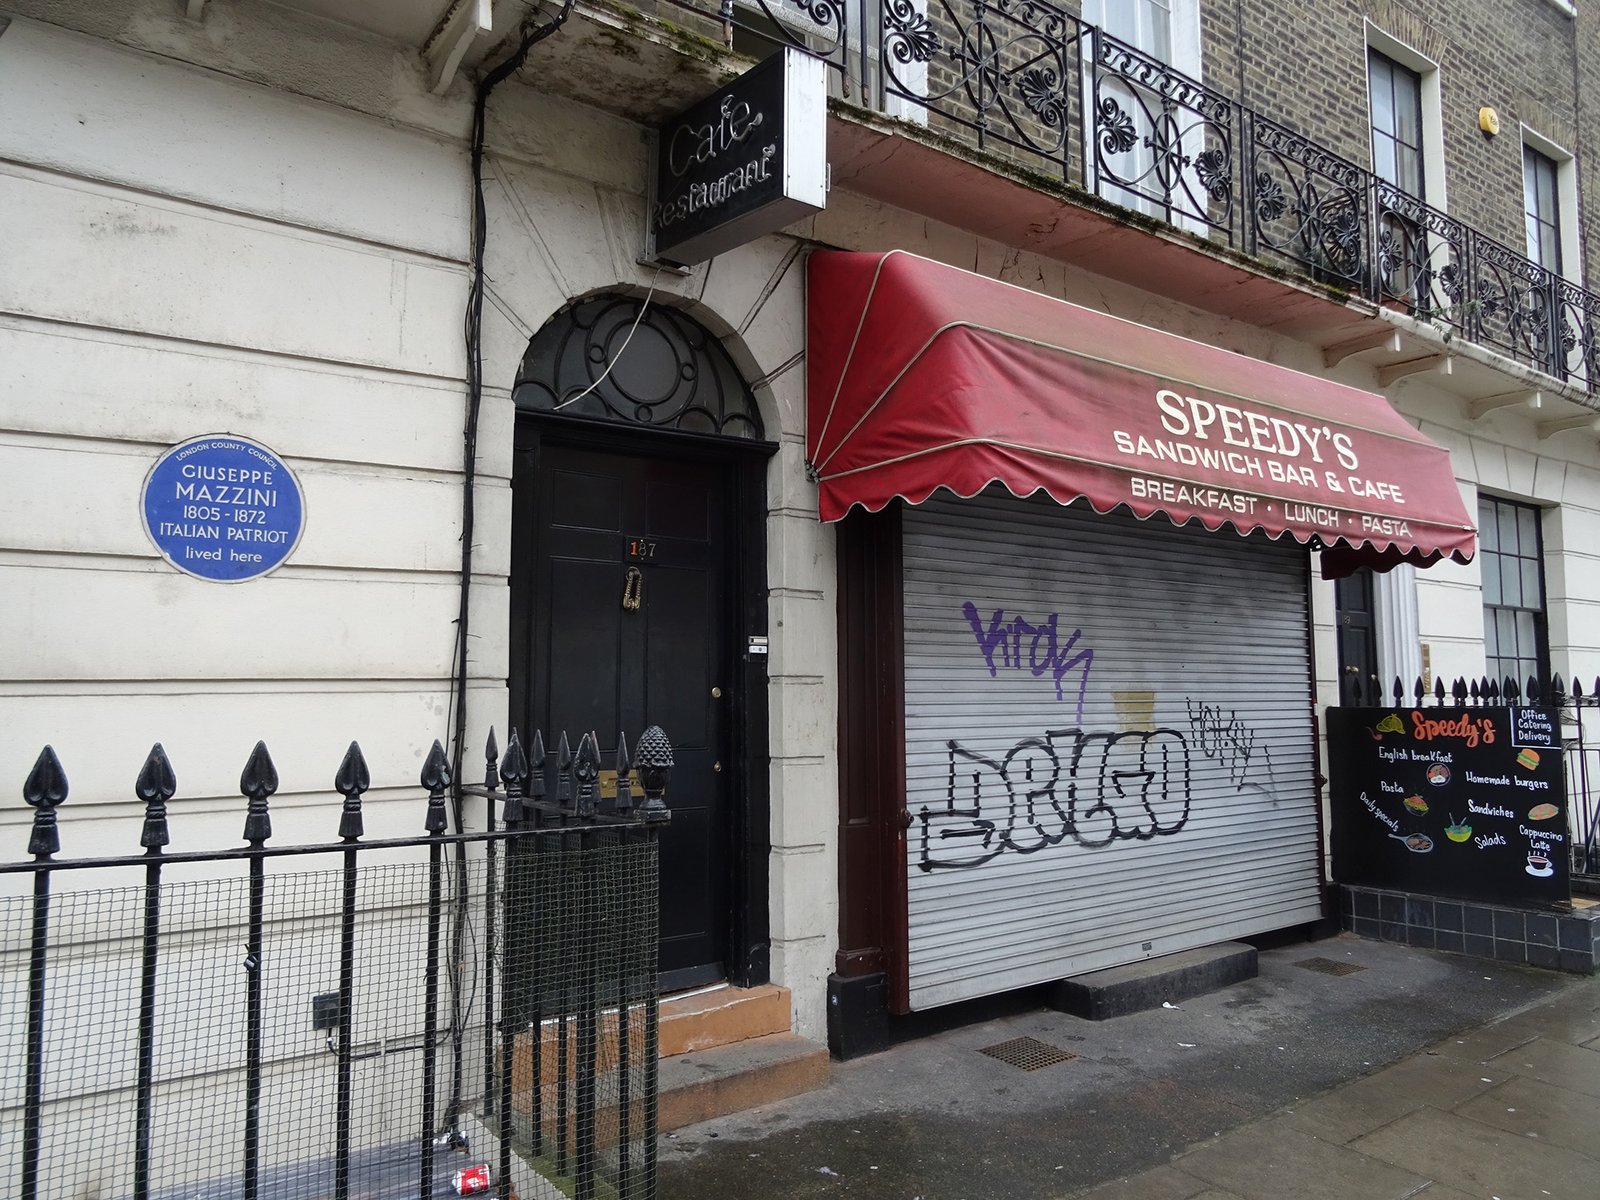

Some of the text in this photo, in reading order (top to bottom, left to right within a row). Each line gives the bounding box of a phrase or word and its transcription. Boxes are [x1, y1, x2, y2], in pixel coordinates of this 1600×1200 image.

[670, 94, 763, 177] Cafe
[1156, 389, 1359, 470] SPEEDY'S
[175, 441, 278, 471] LONDON COUNTY COUNCIL
[182, 464, 273, 486] GIUSEPPE
[1113, 430, 1405, 504] SANDWICH BAR & CAFE
[176, 481, 277, 508] MAZZINI
[1130, 477, 1413, 538] BREAKFAST LUNCH PASTA
[160, 522, 289, 544] ITALIAN PATRIOT
[185, 545, 263, 563] lived here
[630, 541, 657, 557] 187
[1521, 709, 1547, 720] Office
[1411, 710, 1496, 748] Speedy's
[1518, 719, 1552, 732] Catering
[1518, 730, 1551, 745] Delivery
[1378, 746, 1453, 764] English breakfast
[1380, 780, 1405, 793] Pasta
[1465, 771, 1549, 791] Homemade burgers
[1359, 791, 1399, 832] Daily specials
[1467, 799, 1514, 819] Sandwiches
[1474, 832, 1507, 850] Salads
[1519, 824, 1563, 843] Cappuccino
[1530, 839, 1551, 851] Latte
